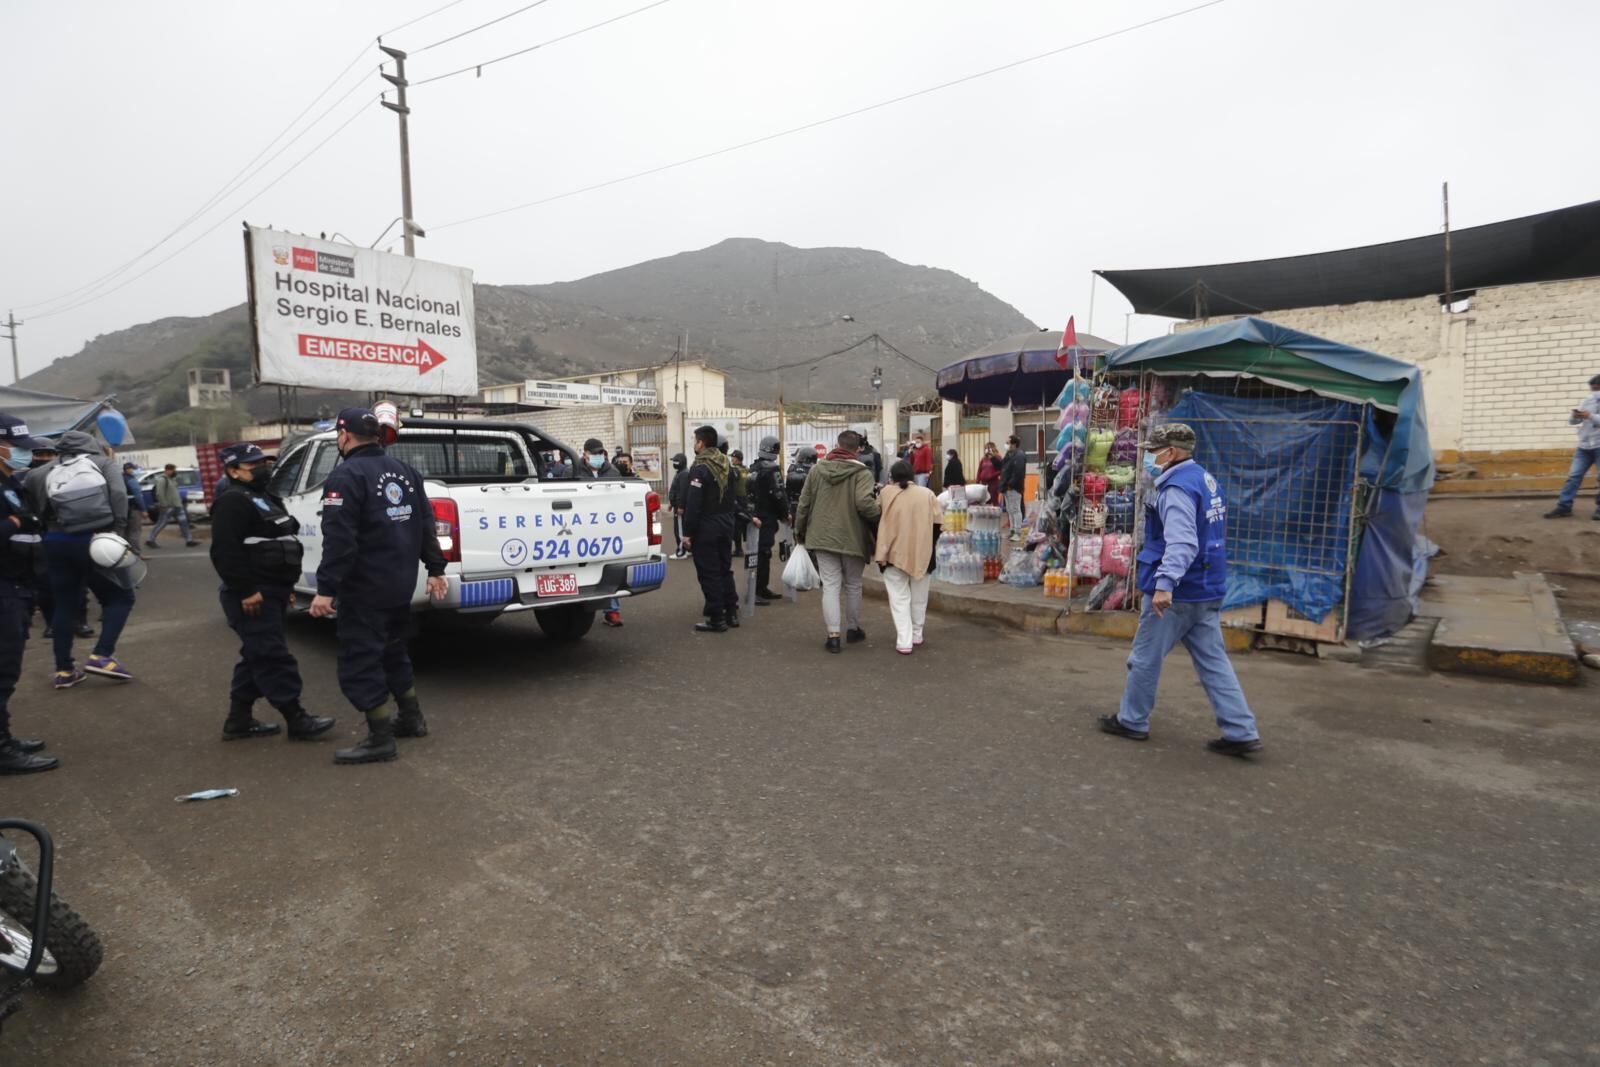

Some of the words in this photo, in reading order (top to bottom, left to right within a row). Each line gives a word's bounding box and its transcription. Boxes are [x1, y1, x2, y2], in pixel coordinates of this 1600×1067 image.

[295, 255, 315, 265] PERÚ
[319, 263, 329, 271] de
[330, 265, 350, 275] Salud
[275, 271, 369, 303] Hospital
[376, 288, 461, 317] Nacional
[277, 298, 348, 325] Sergio
[355, 309, 374, 327] E.
[380, 313, 461, 337] Bernales
[306, 338, 433, 366] EMERGENCIA
[479, 511, 634, 530] SERENAZGO
[532, 539, 570, 561] 524
[577, 536, 623, 558] 0670
